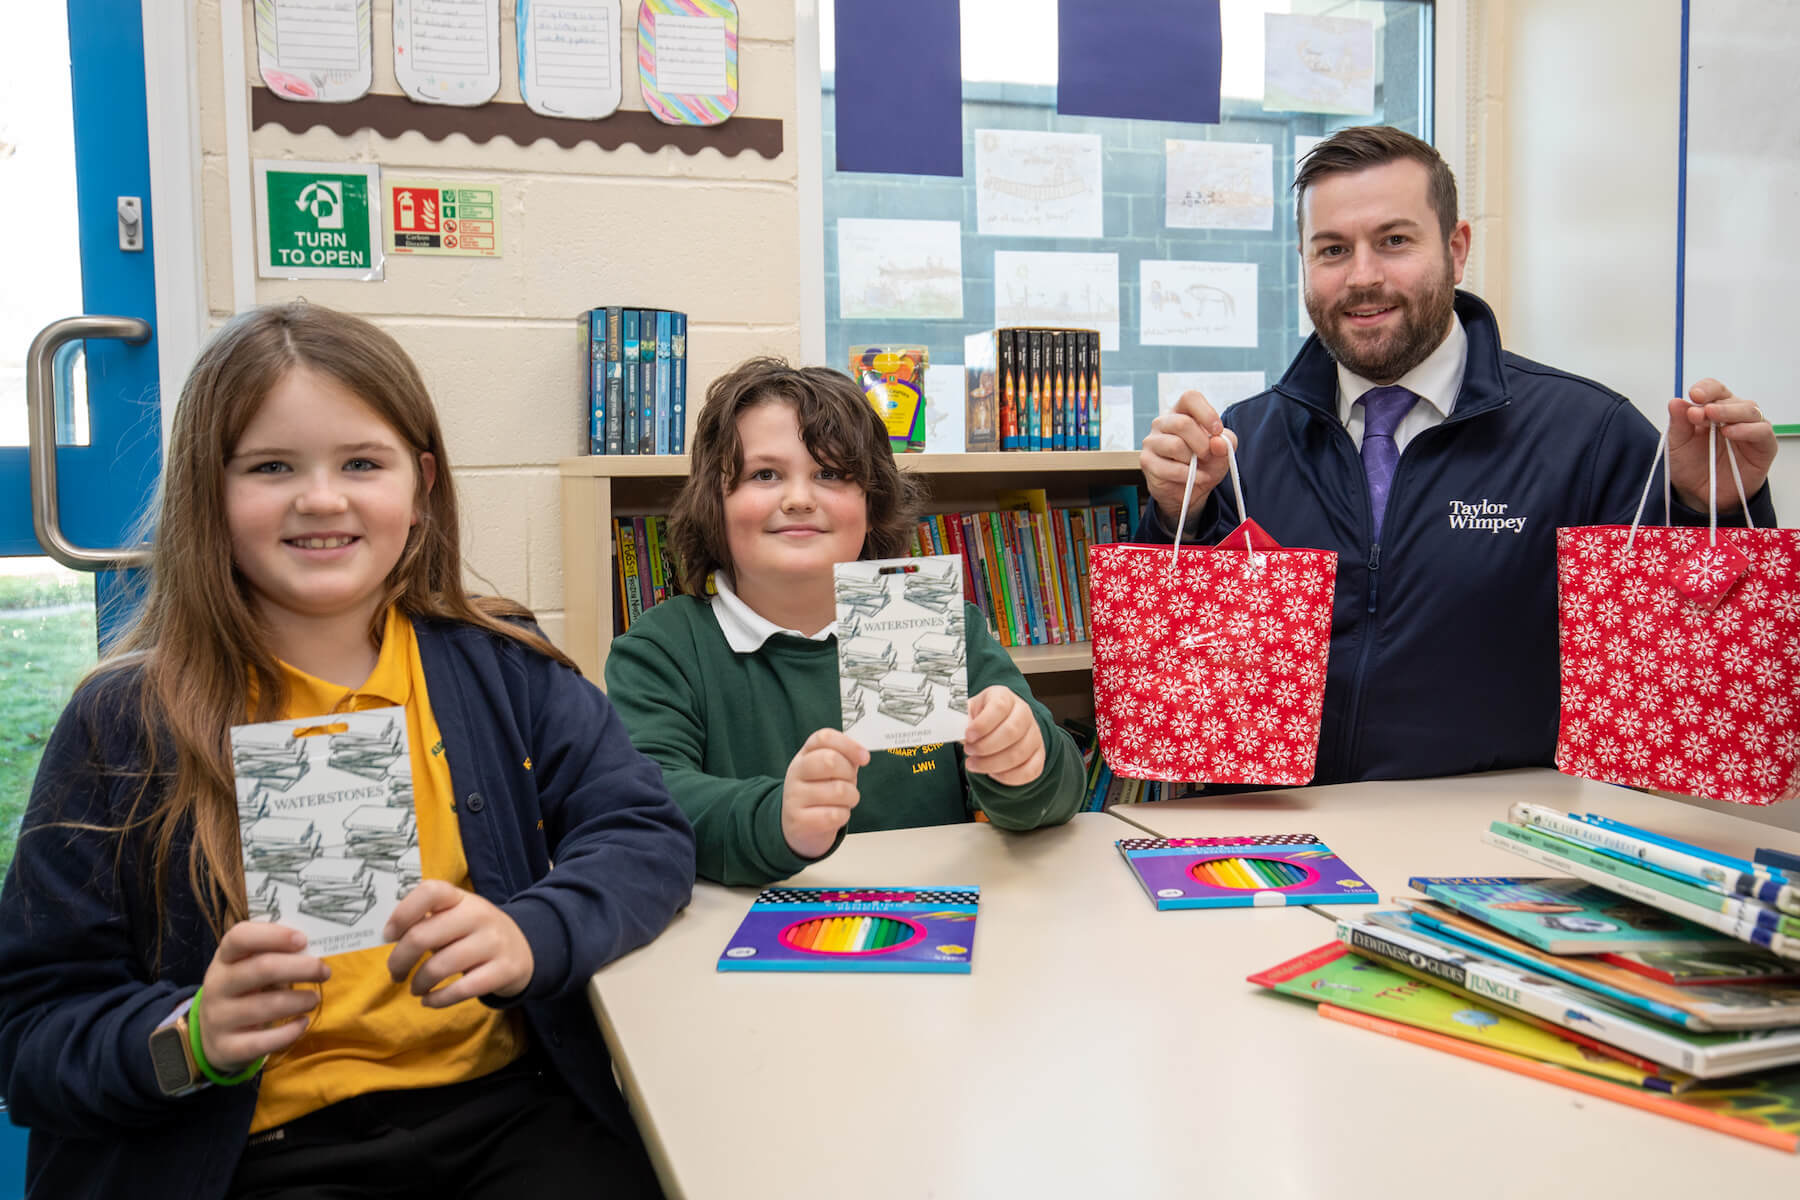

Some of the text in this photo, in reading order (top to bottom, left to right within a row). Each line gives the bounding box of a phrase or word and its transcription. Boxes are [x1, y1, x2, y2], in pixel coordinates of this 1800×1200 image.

[294, 231, 347, 247] TURN
[278, 249, 364, 266] TO OPEN
[1449, 499, 1508, 519] Taylor
[1448, 514, 1527, 534] Wimpey
[864, 616, 945, 632] WATERSTONES
[888, 746, 917, 757] RIMARY
[912, 760, 936, 774] LWH
[274, 784, 385, 809] WATERSTONES
[1353, 931, 1411, 963] EYEWITNESS
[1427, 959, 1466, 985] GUIDES
[1470, 974, 1521, 1003] JUNGLE
